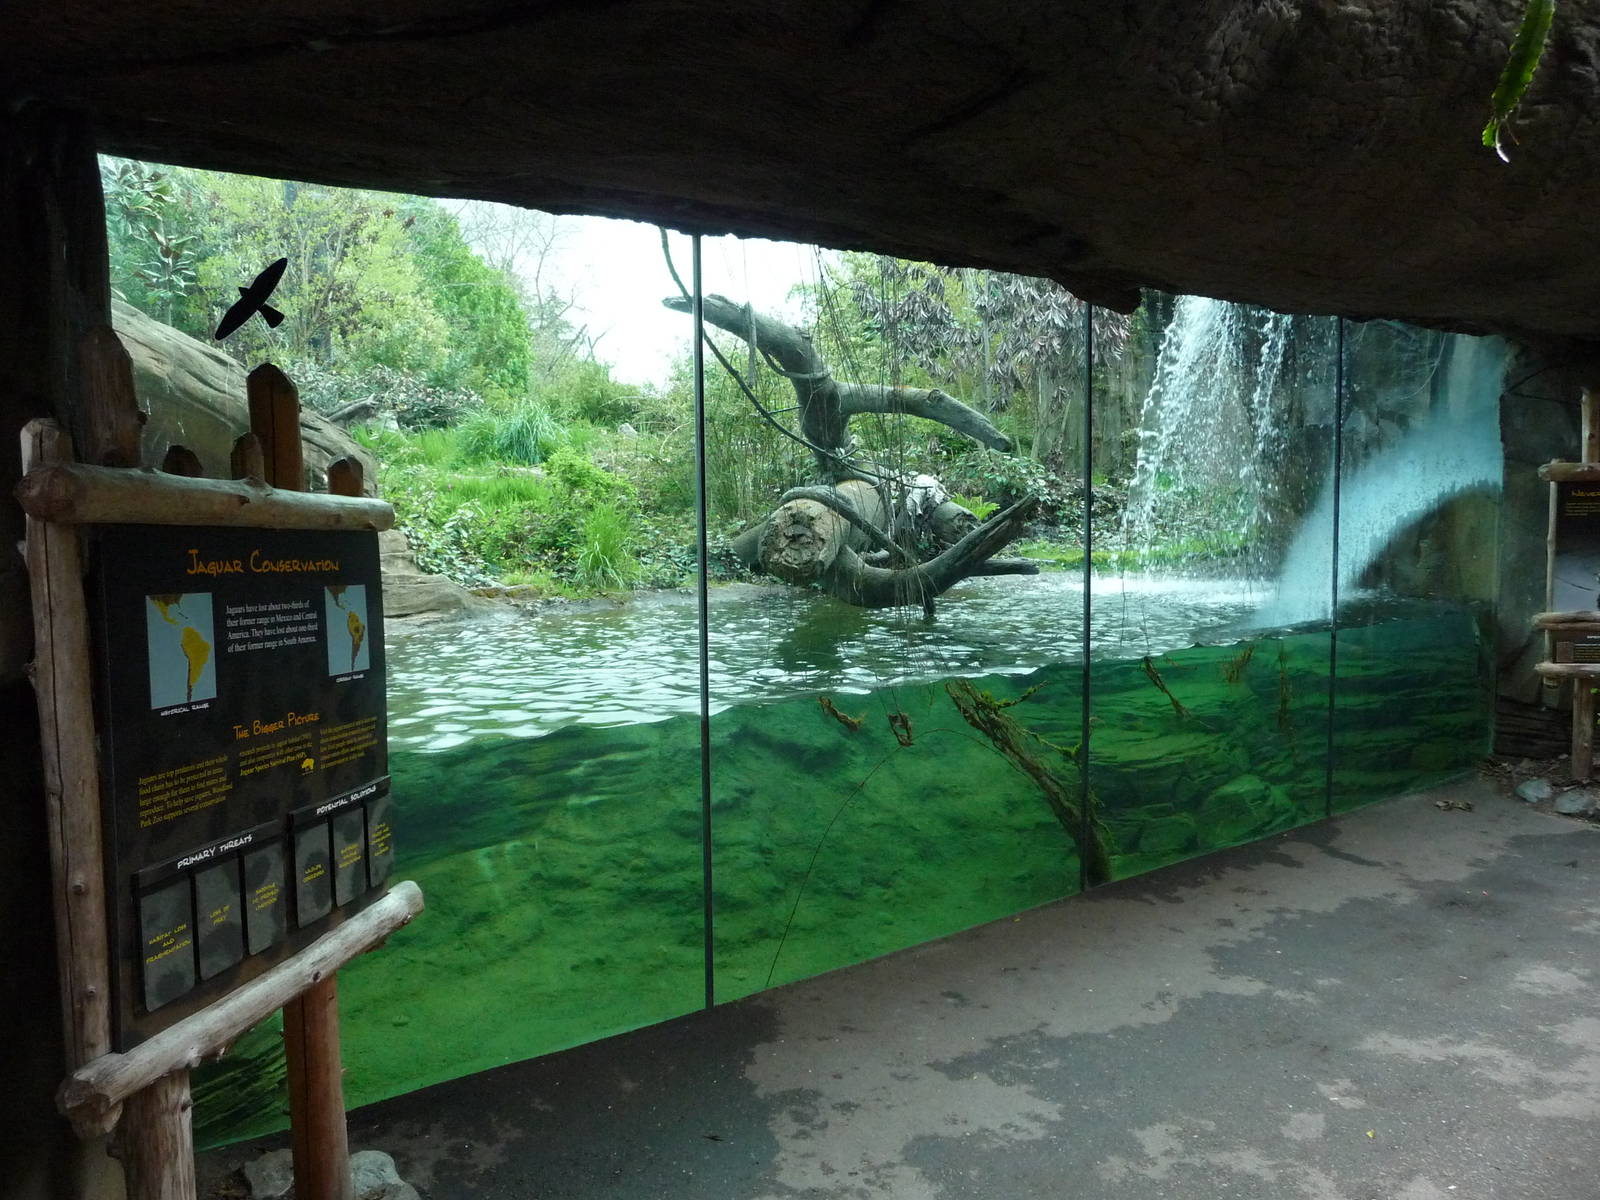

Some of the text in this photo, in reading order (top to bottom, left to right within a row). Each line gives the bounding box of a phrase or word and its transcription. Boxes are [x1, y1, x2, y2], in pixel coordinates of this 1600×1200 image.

[187, 548, 341, 577] JAGUAR CONSERVATION
[233, 725, 250, 741] THE
[253, 719, 286, 736] BIGGER
[287, 712, 320, 727] PICTURE
[316, 785, 377, 816] POTENTIAL SOLUTIONS
[177, 834, 253, 870] PRIMARY THREATS
